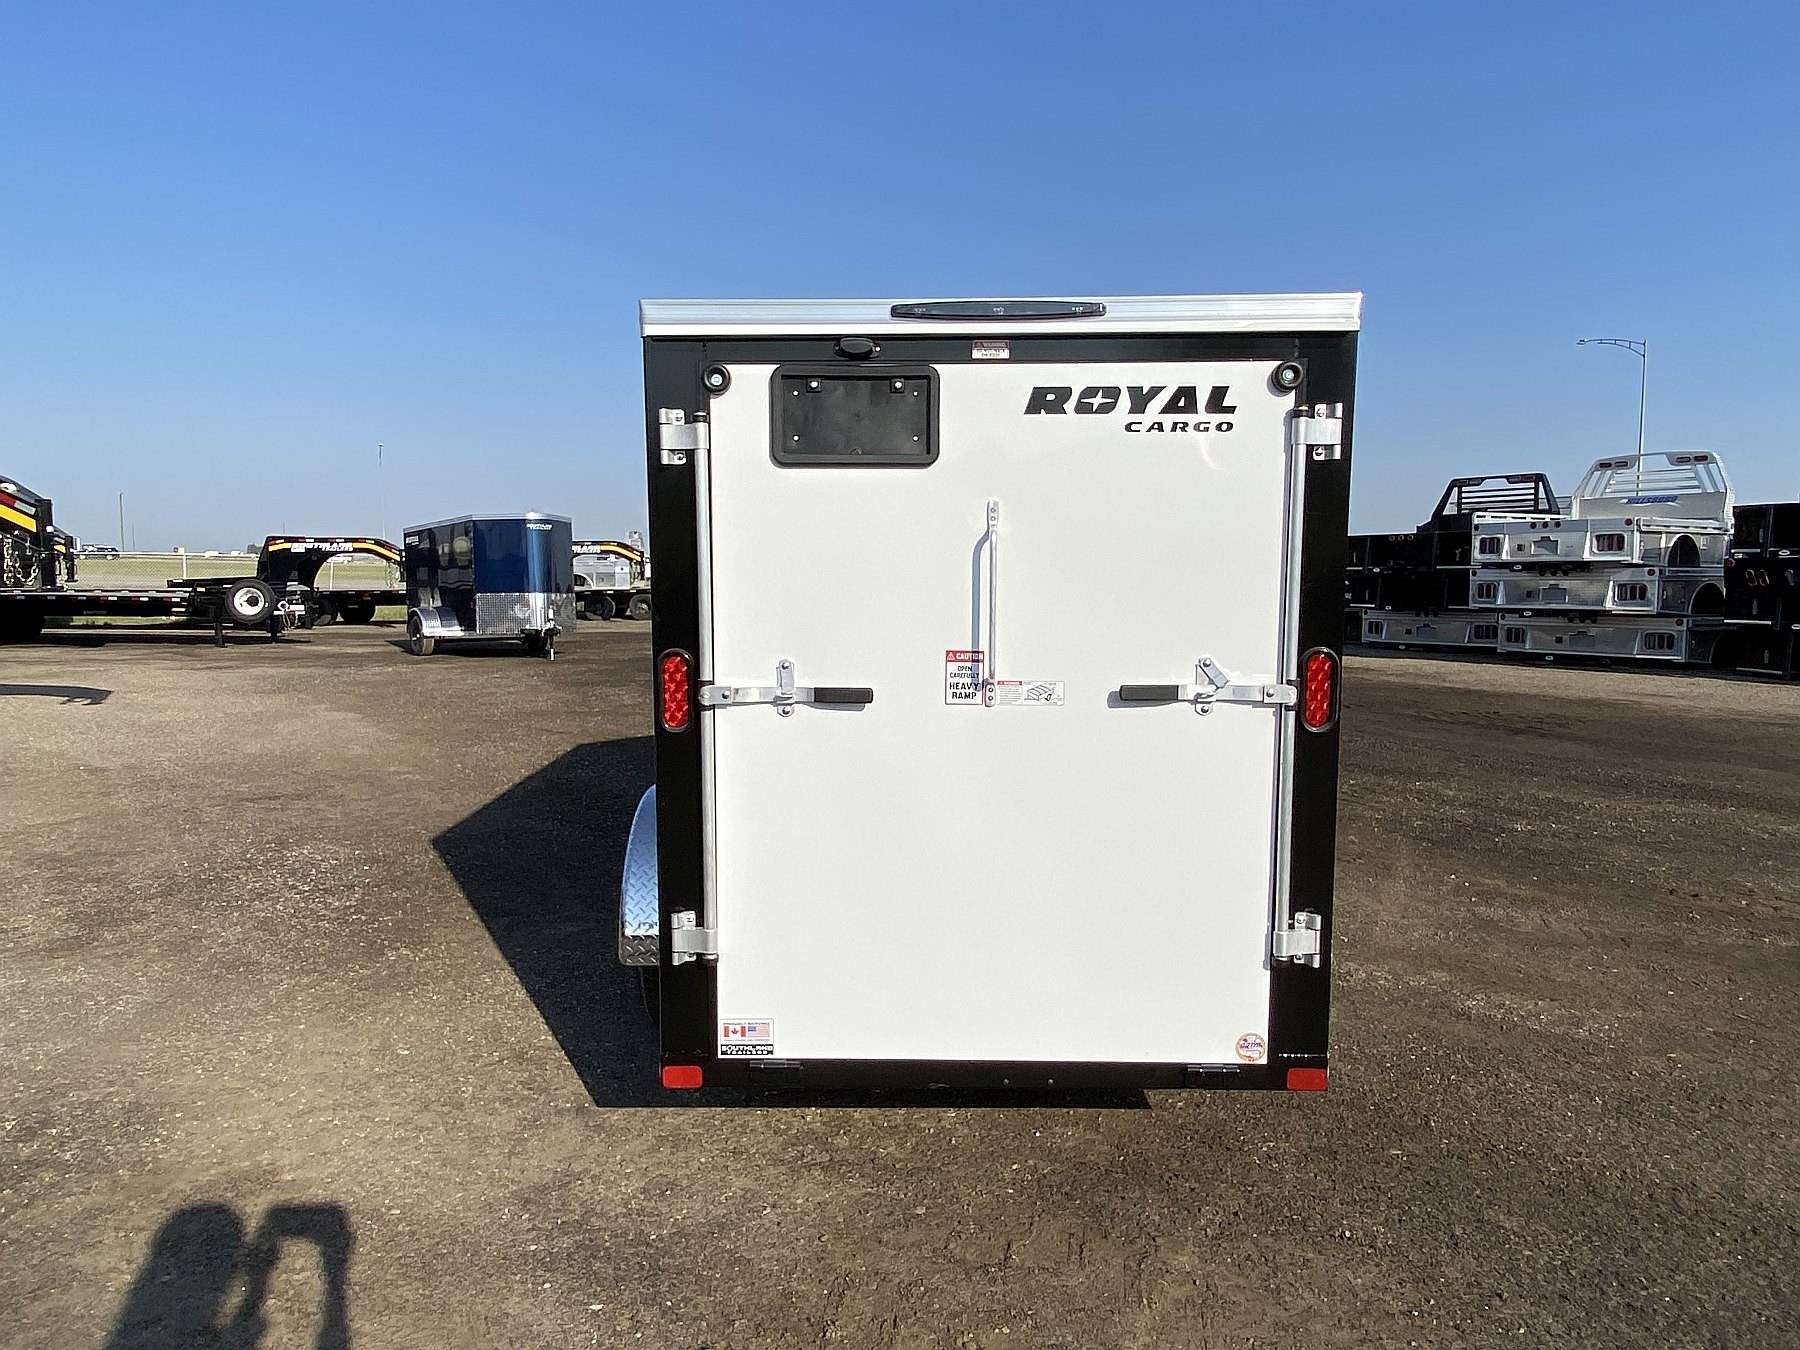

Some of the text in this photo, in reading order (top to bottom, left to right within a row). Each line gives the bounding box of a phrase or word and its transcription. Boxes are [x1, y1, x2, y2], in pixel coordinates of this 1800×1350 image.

[1024, 386, 1237, 415] ROYAL
[1124, 421, 1234, 433] CARGO
[956, 652, 983, 660] CAUTION
[949, 682, 980, 690] HEAVY
[951, 692, 977, 700] RAMP
